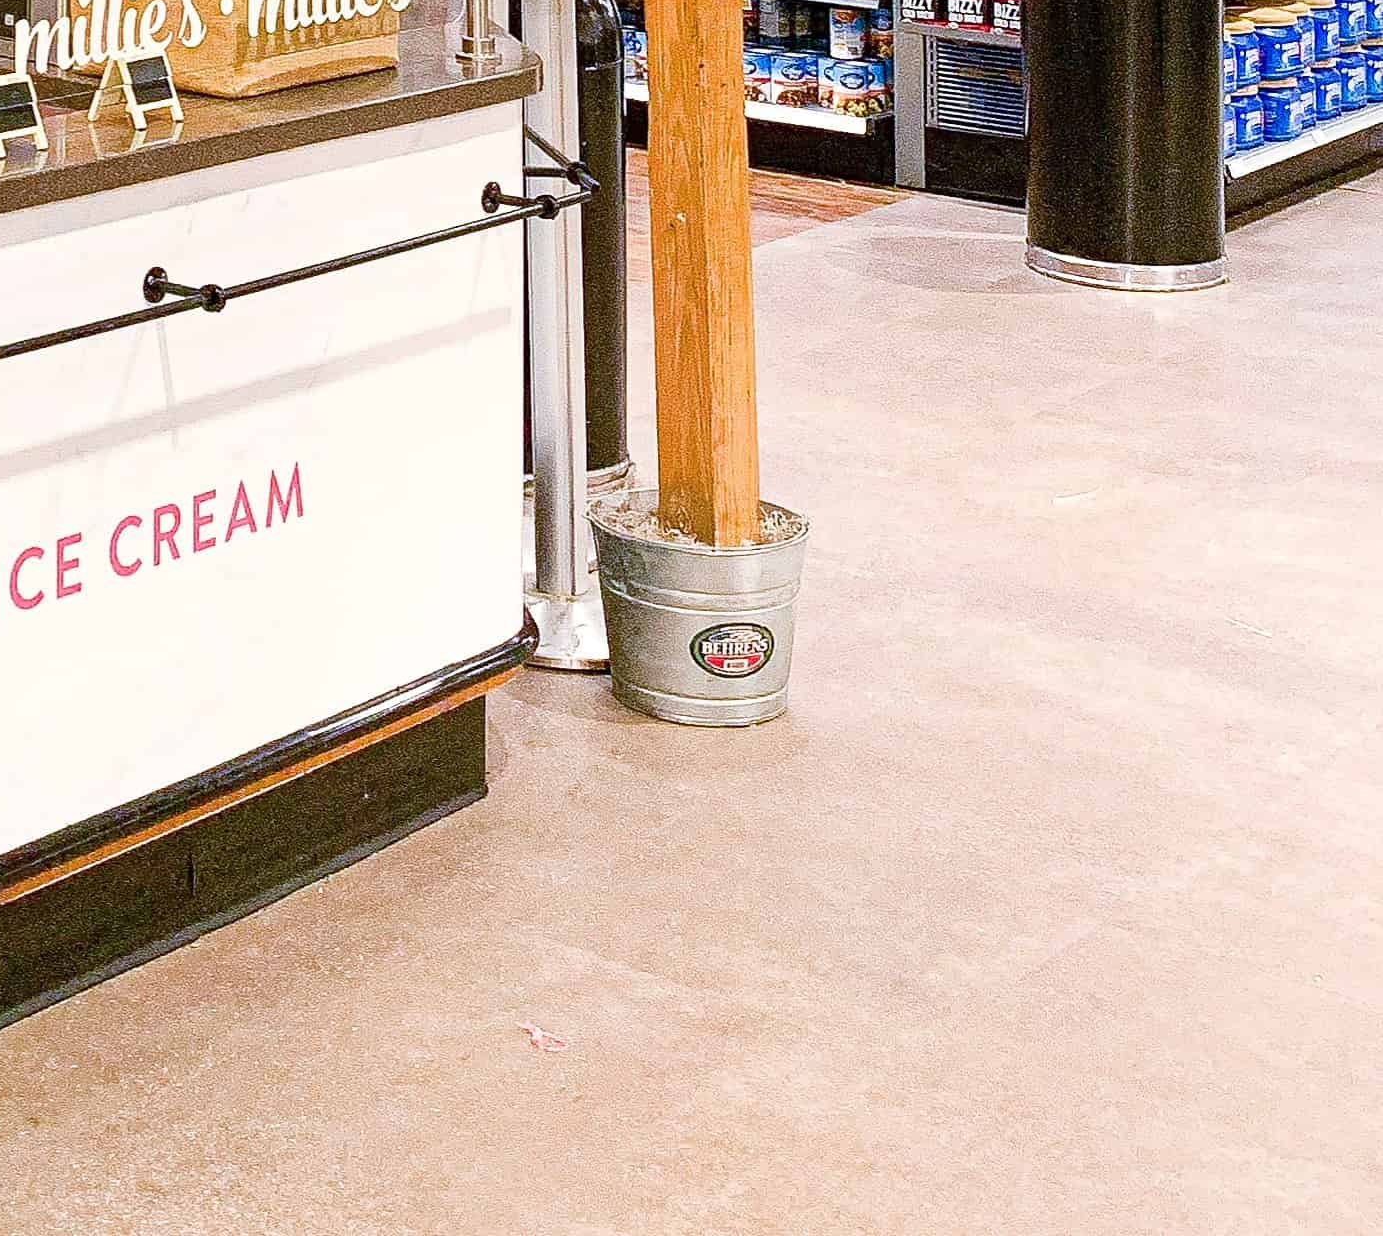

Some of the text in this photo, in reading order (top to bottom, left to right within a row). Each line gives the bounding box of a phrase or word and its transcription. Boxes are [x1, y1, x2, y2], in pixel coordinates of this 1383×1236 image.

[994, 3, 1020, 20] BIZZ
[108, 461, 305, 577] CREAM
[701, 638, 769, 655] BEHRENS
